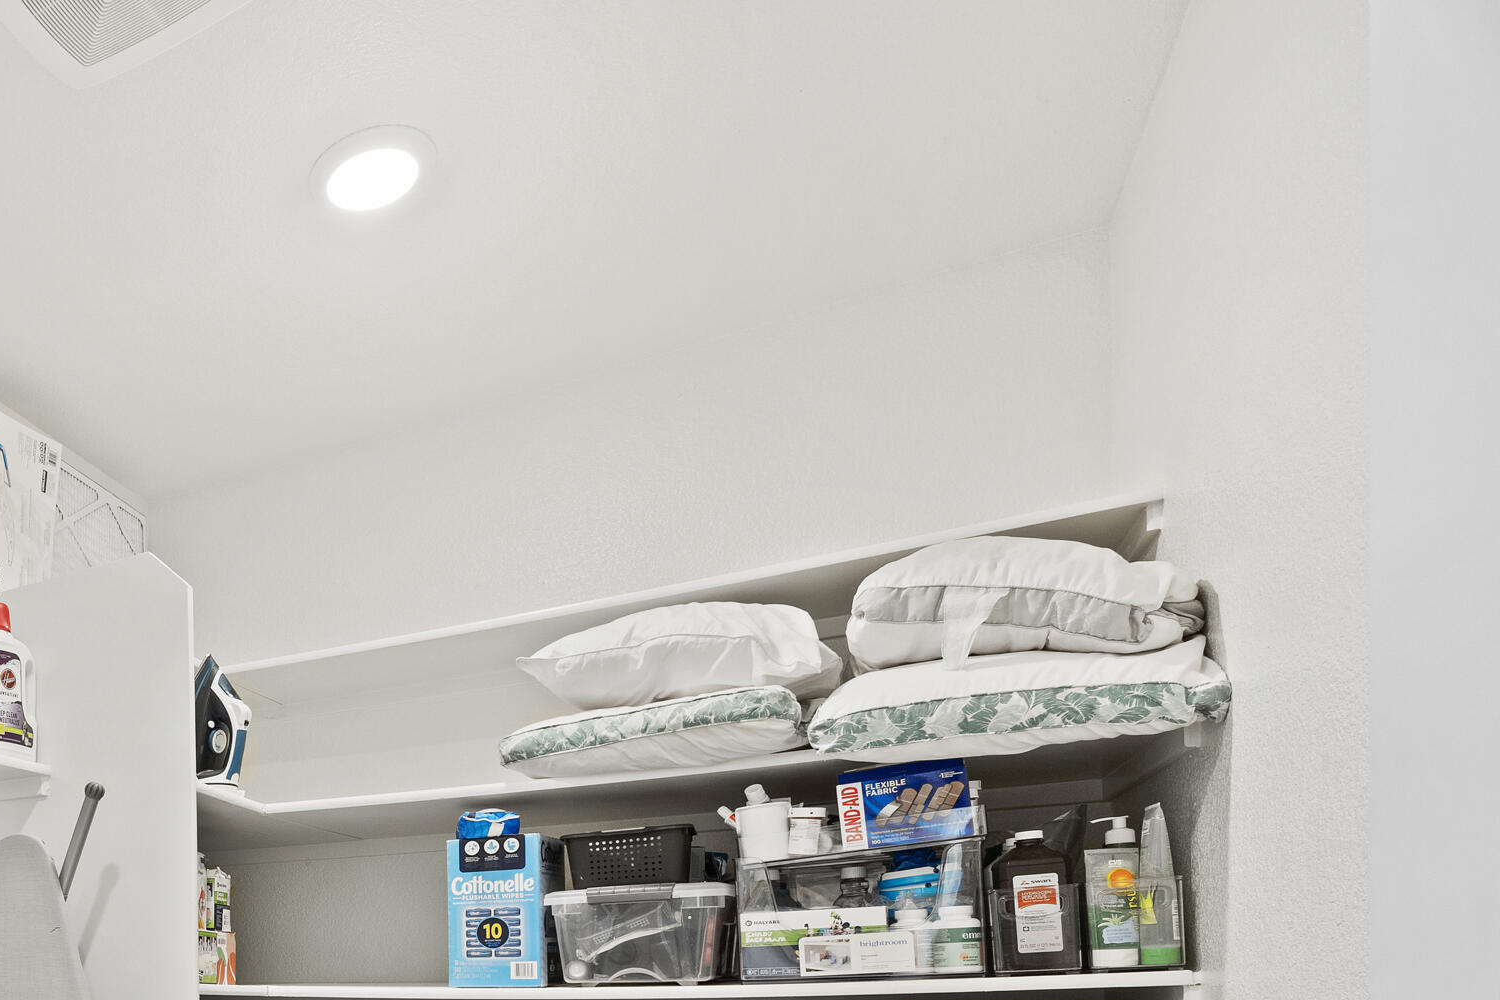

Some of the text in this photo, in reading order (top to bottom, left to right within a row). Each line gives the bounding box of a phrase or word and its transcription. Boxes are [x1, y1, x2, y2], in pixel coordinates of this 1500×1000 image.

[6, 710, 18, 718] CLEAN
[865, 778, 906, 790] FLEXIBLE
[866, 786, 898, 798] FABRIC
[451, 873, 535, 896] Cottonelle
[483, 922, 502, 940] 10
[860, 939, 908, 948] brightroom
